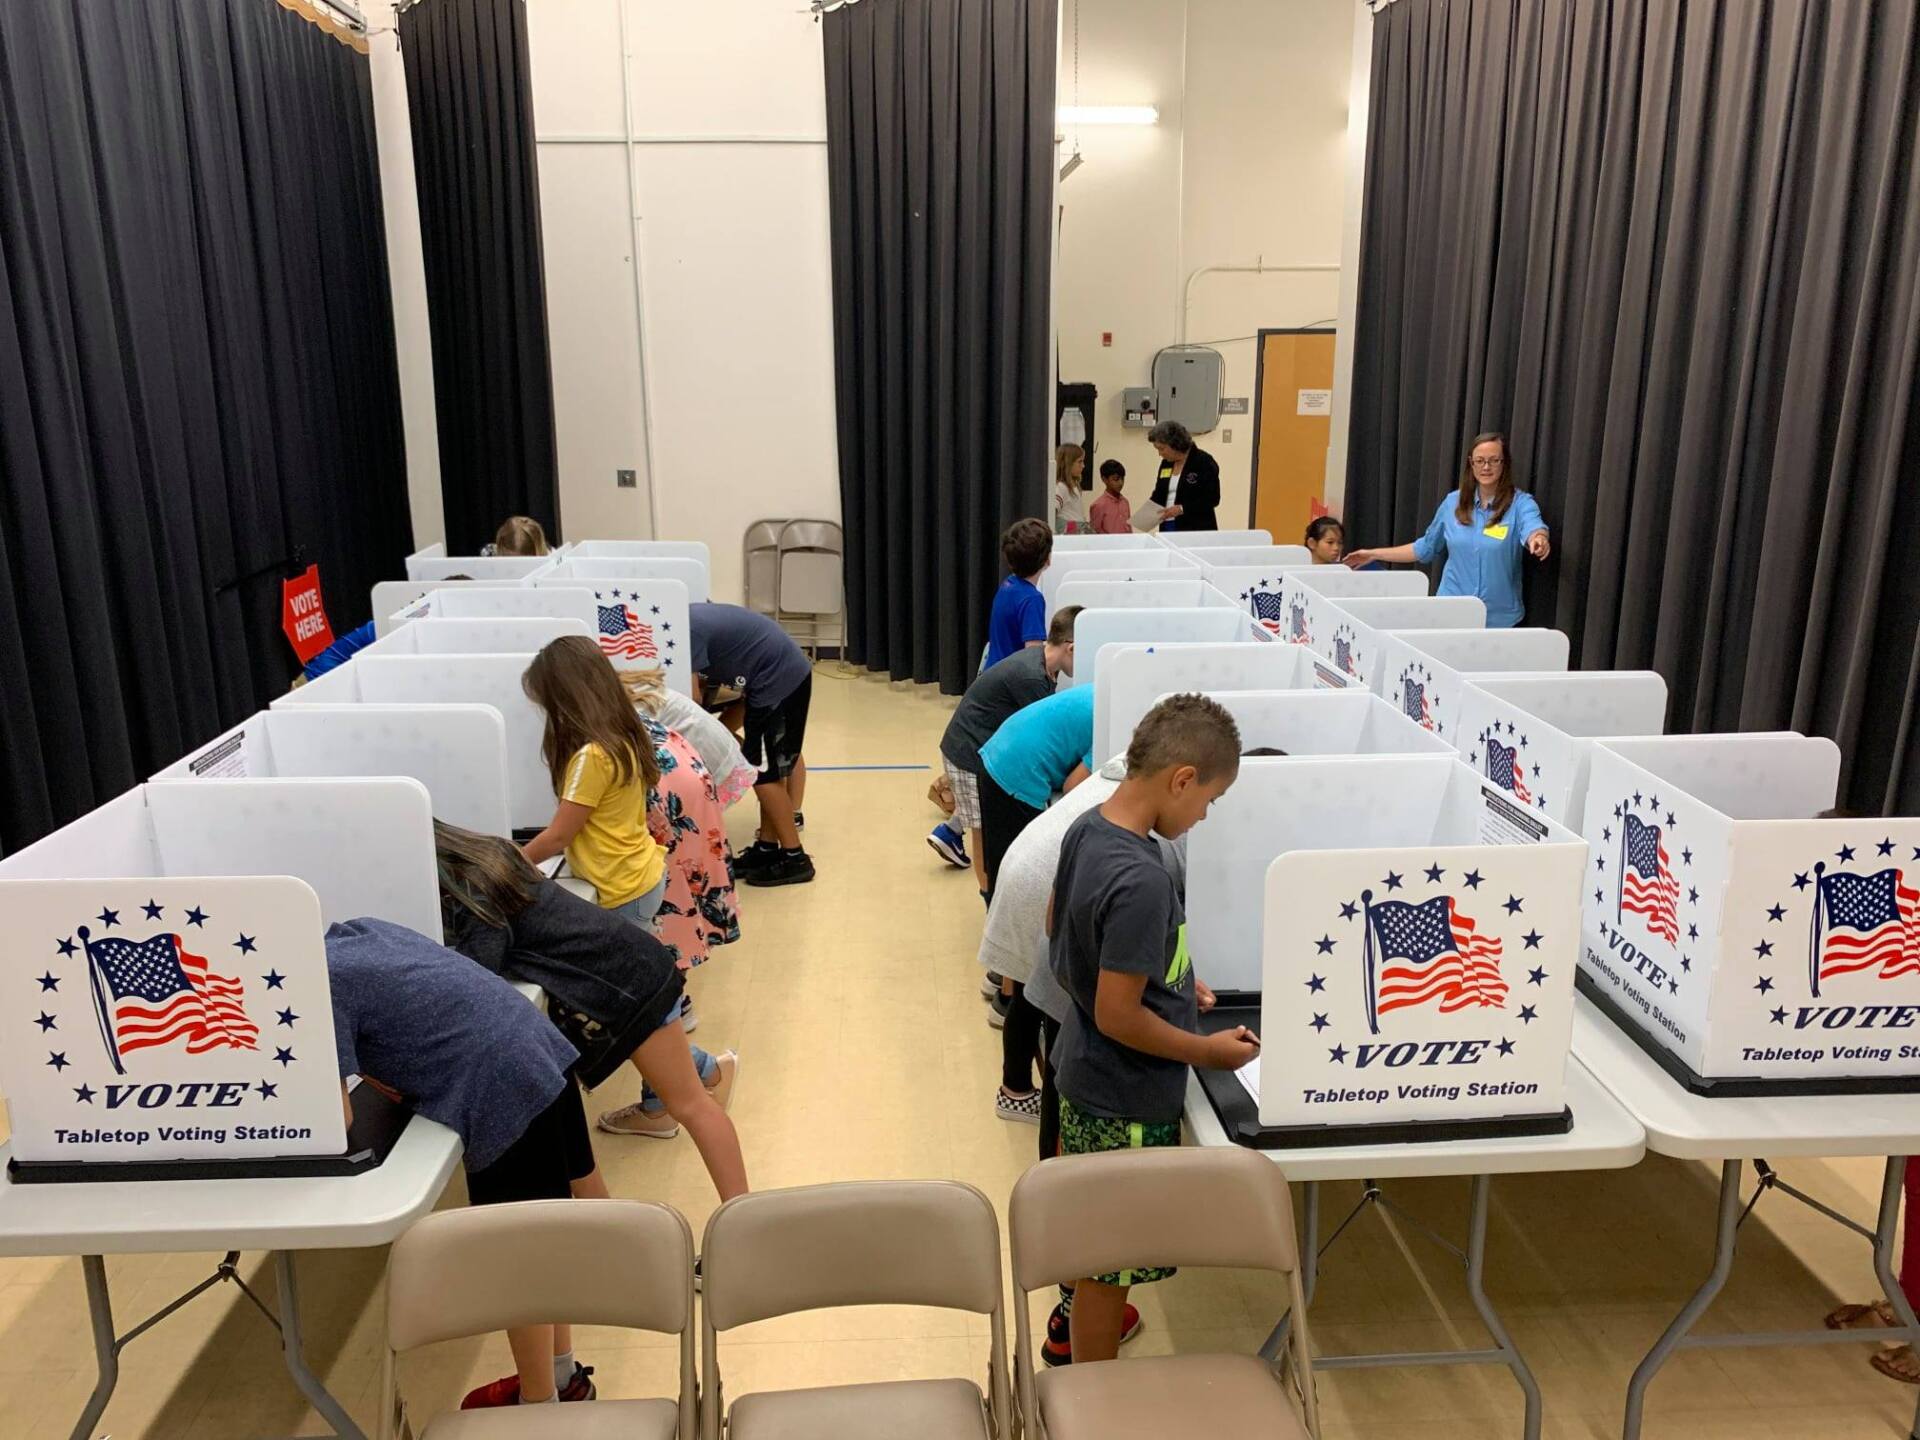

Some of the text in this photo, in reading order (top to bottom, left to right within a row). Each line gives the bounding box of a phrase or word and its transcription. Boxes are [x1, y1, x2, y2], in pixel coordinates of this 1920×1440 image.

[289, 588, 320, 617] VOTE
[295, 611, 326, 642] HERE
[1609, 929, 1668, 988] VOTE
[1587, 947, 1686, 1044] Tabletop Voting Station
[1794, 1005, 1920, 1030] VOTE
[1355, 1040, 1491, 1069] VOTE
[1742, 1047, 1825, 1063] Tabletop
[1832, 1046, 1892, 1062] Voting
[104, 1082, 250, 1109] VOTE
[1303, 1081, 1538, 1103] Tabletop Voting Station
[55, 1125, 311, 1145] Tabletop Voting Station
